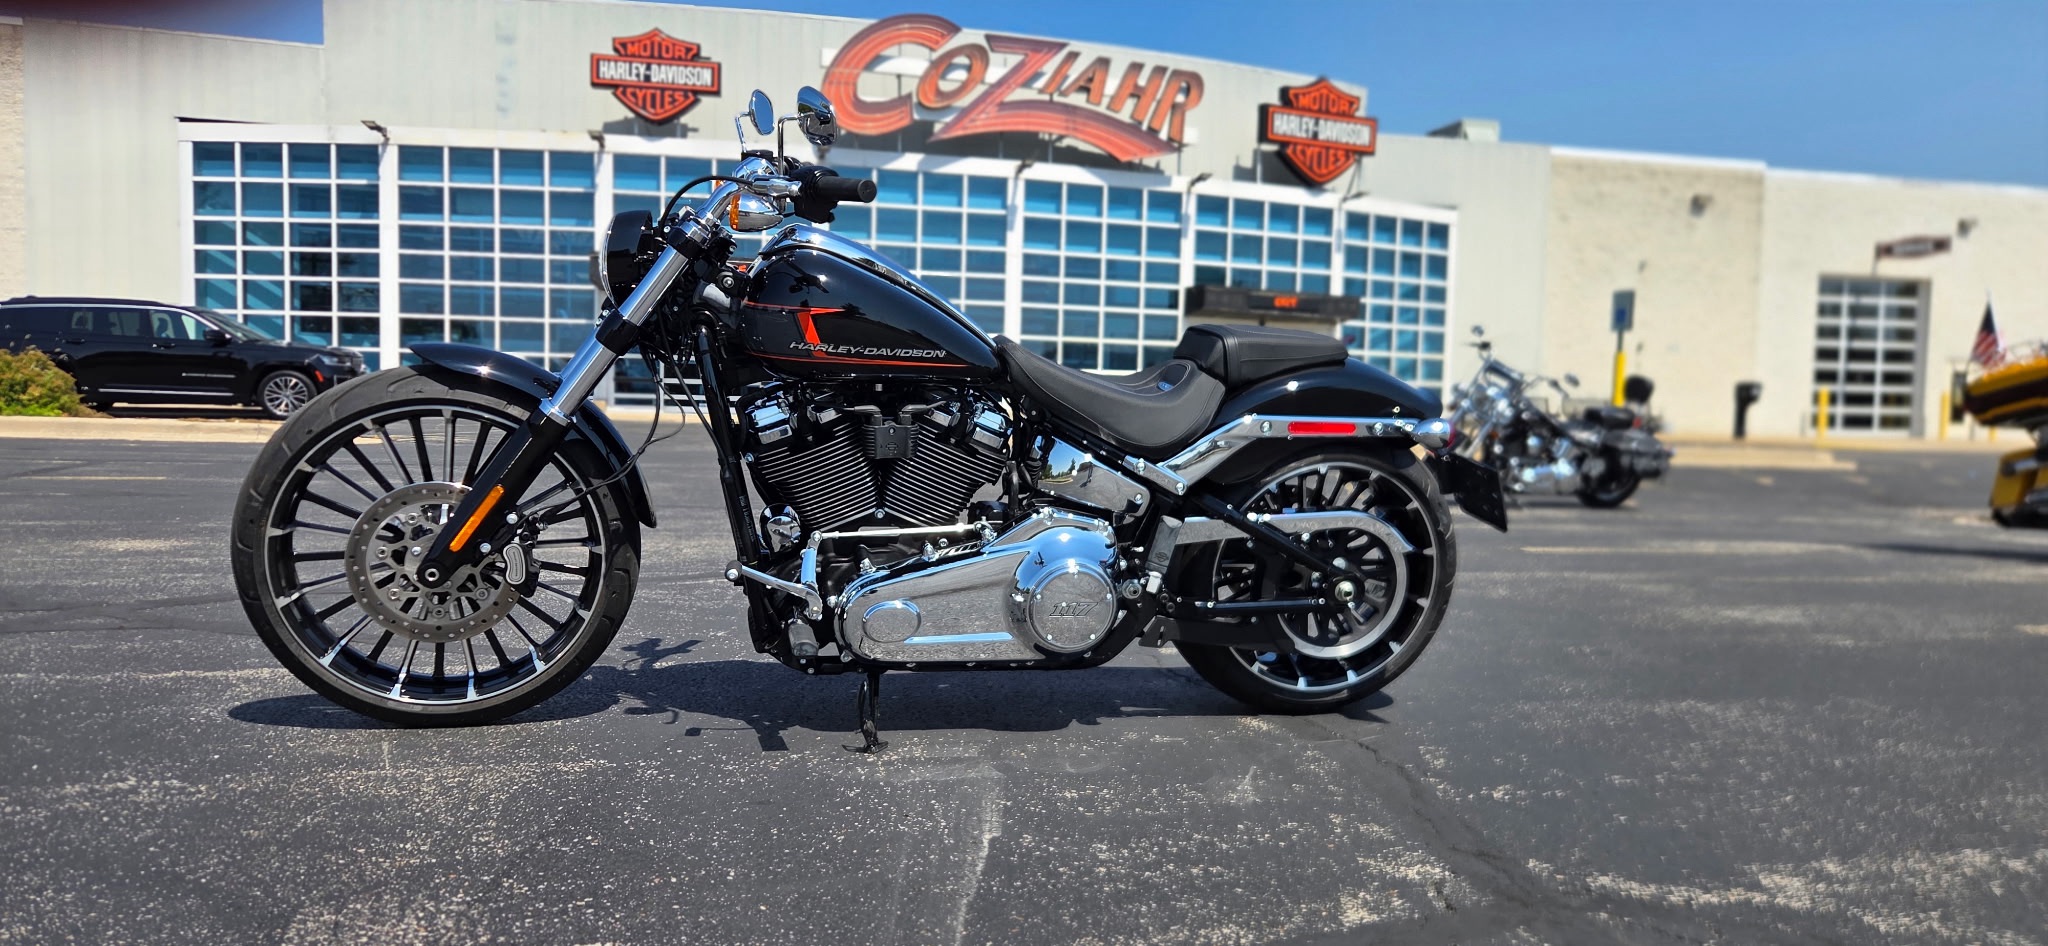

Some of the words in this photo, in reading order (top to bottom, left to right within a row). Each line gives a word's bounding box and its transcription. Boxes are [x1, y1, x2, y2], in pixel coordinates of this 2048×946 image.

[627, 39, 686, 60] MOTOR
[598, 59, 712, 87] HARLEY-DAVIDSON
[626, 87, 686, 114] CYCLES
[1298, 89, 1351, 114] MOTOR
[1273, 112, 1370, 147] HARLEY-DAVIDSON
[1296, 144, 1346, 174] CYCLES
[789, 341, 945, 358] HARLEY-DAVIDSON
[1049, 601, 1098, 617] 117
